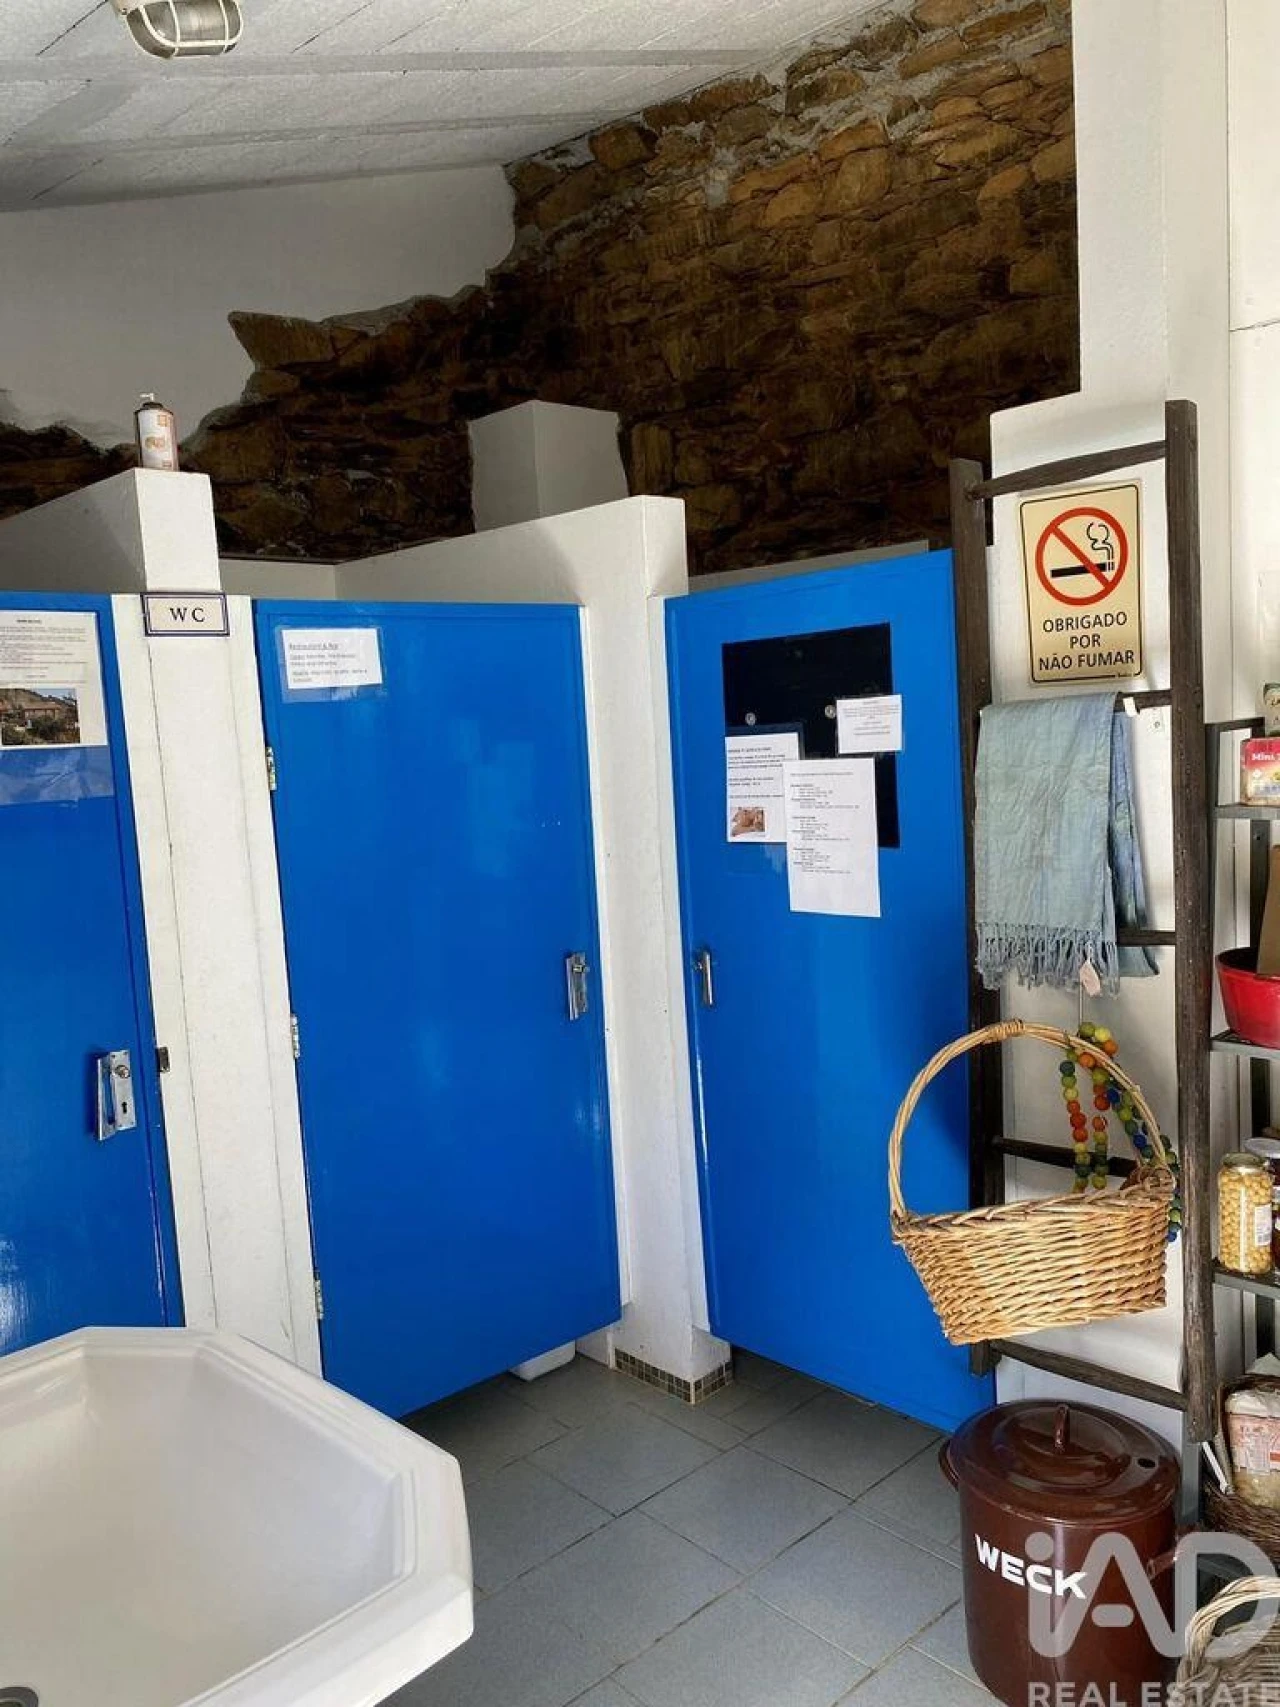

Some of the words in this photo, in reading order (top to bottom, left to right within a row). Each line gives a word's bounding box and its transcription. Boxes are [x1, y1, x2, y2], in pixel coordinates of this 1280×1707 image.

[169, 607, 206, 623] WC
[1042, 611, 1128, 633] OBRIGADO
[1069, 633, 1102, 649] POR
[1039, 653, 1073, 671] NÃO
[1077, 650, 1135, 668] FUMAR
[974, 1533, 1088, 1600] WECK
